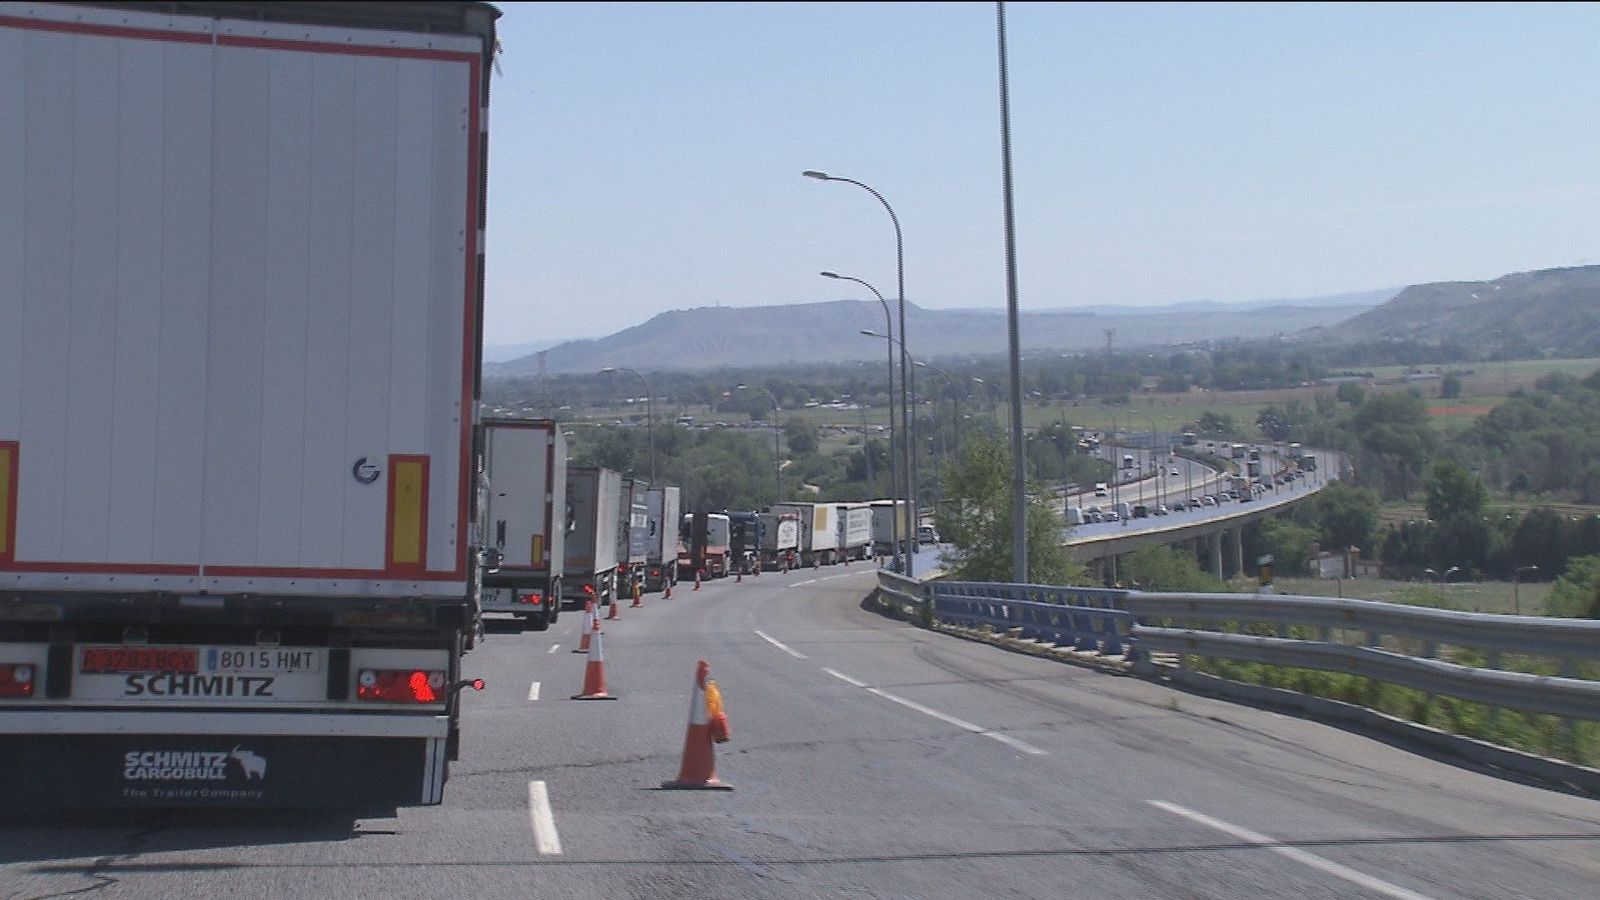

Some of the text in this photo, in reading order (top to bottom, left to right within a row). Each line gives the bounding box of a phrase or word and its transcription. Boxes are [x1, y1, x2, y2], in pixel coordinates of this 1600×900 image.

[220, 651, 314, 669] 8015 HMT
[124, 674, 274, 698] SCHMITZ
[124, 751, 227, 767] SCHMITZ
[123, 766, 227, 780] CARGOBULL
[123, 788, 147, 798] The
